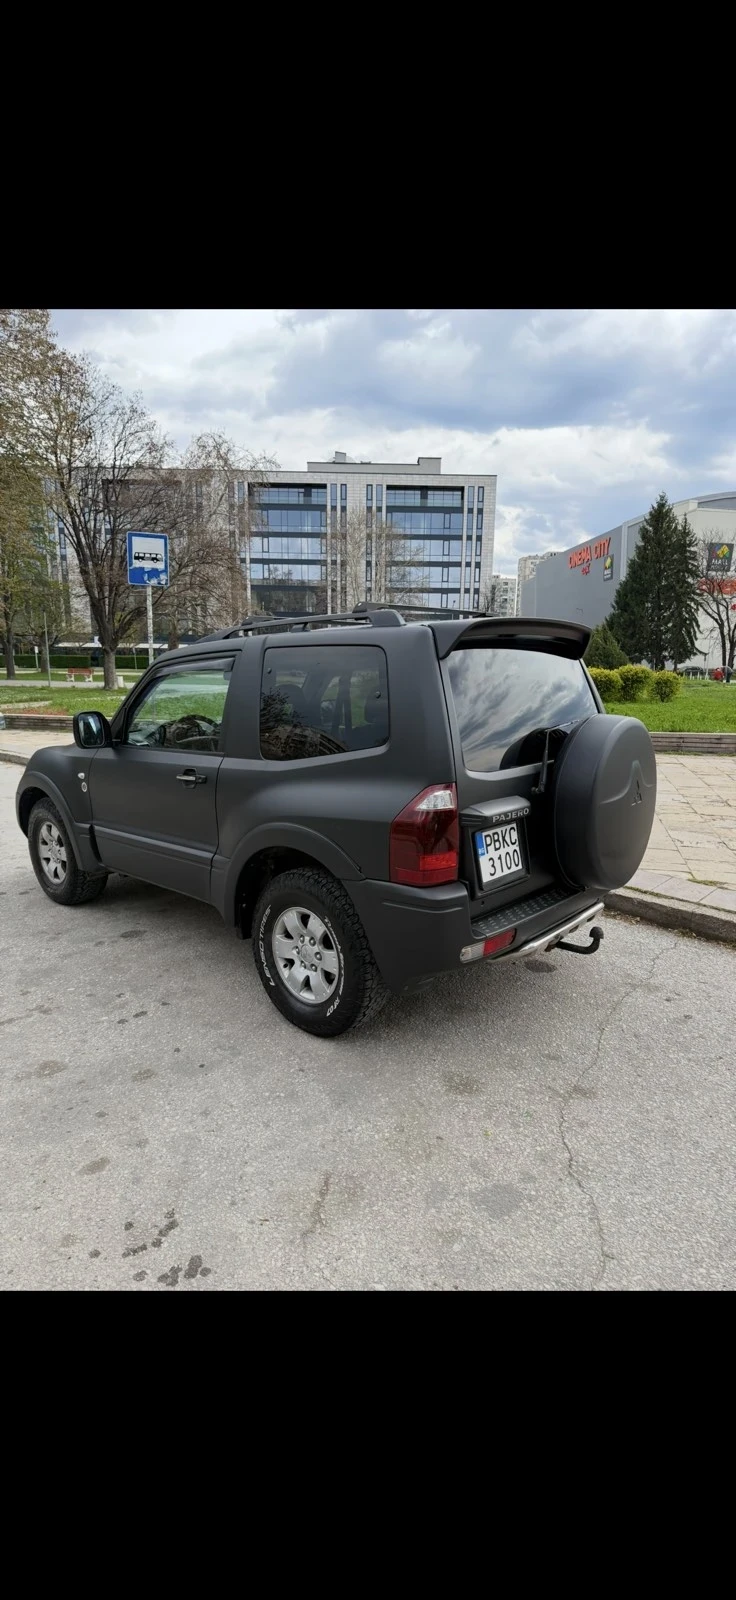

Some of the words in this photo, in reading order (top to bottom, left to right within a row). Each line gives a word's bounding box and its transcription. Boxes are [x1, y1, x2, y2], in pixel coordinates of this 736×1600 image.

[568, 545, 592, 569] CINEMA
[594, 536, 611, 560] CITY
[492, 807, 530, 823] PAJERO
[484, 826, 518, 855] PBKC
[488, 849, 520, 877] 3100
